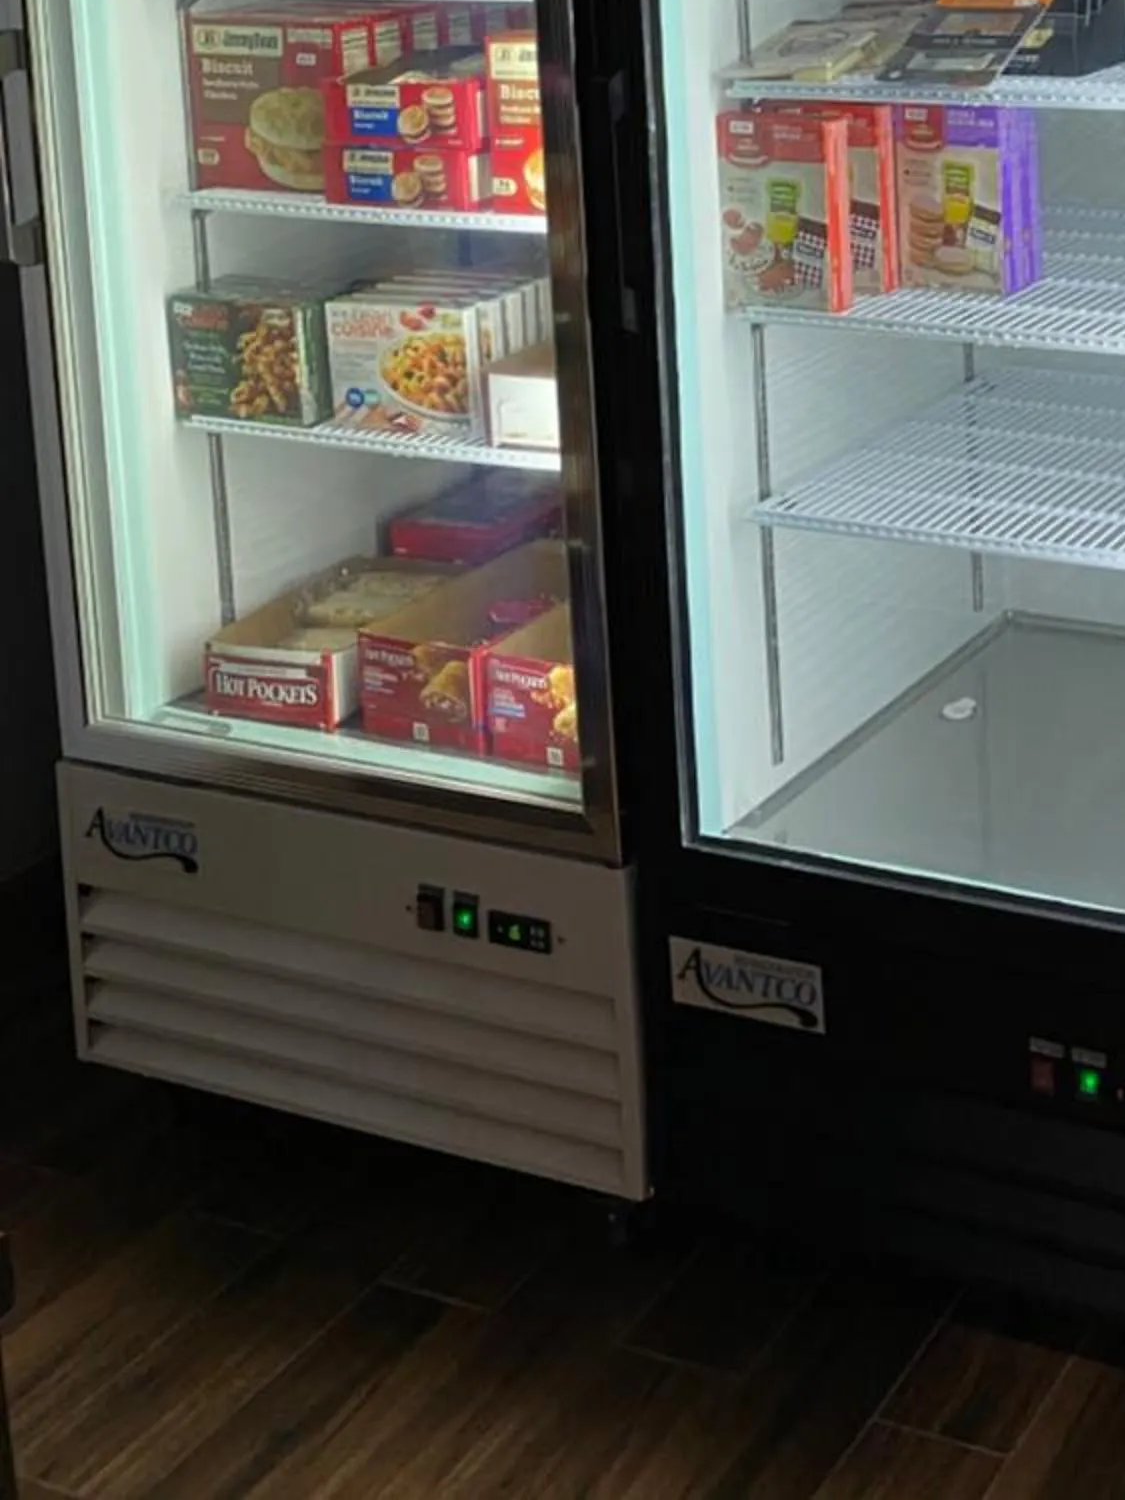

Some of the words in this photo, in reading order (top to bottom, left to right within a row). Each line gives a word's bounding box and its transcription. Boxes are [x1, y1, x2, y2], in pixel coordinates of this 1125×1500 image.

[215, 673, 246, 697] HOT
[247, 677, 318, 706] POCKETS
[85, 806, 199, 866] AVANTCO
[677, 948, 818, 1019] AVANTCO
